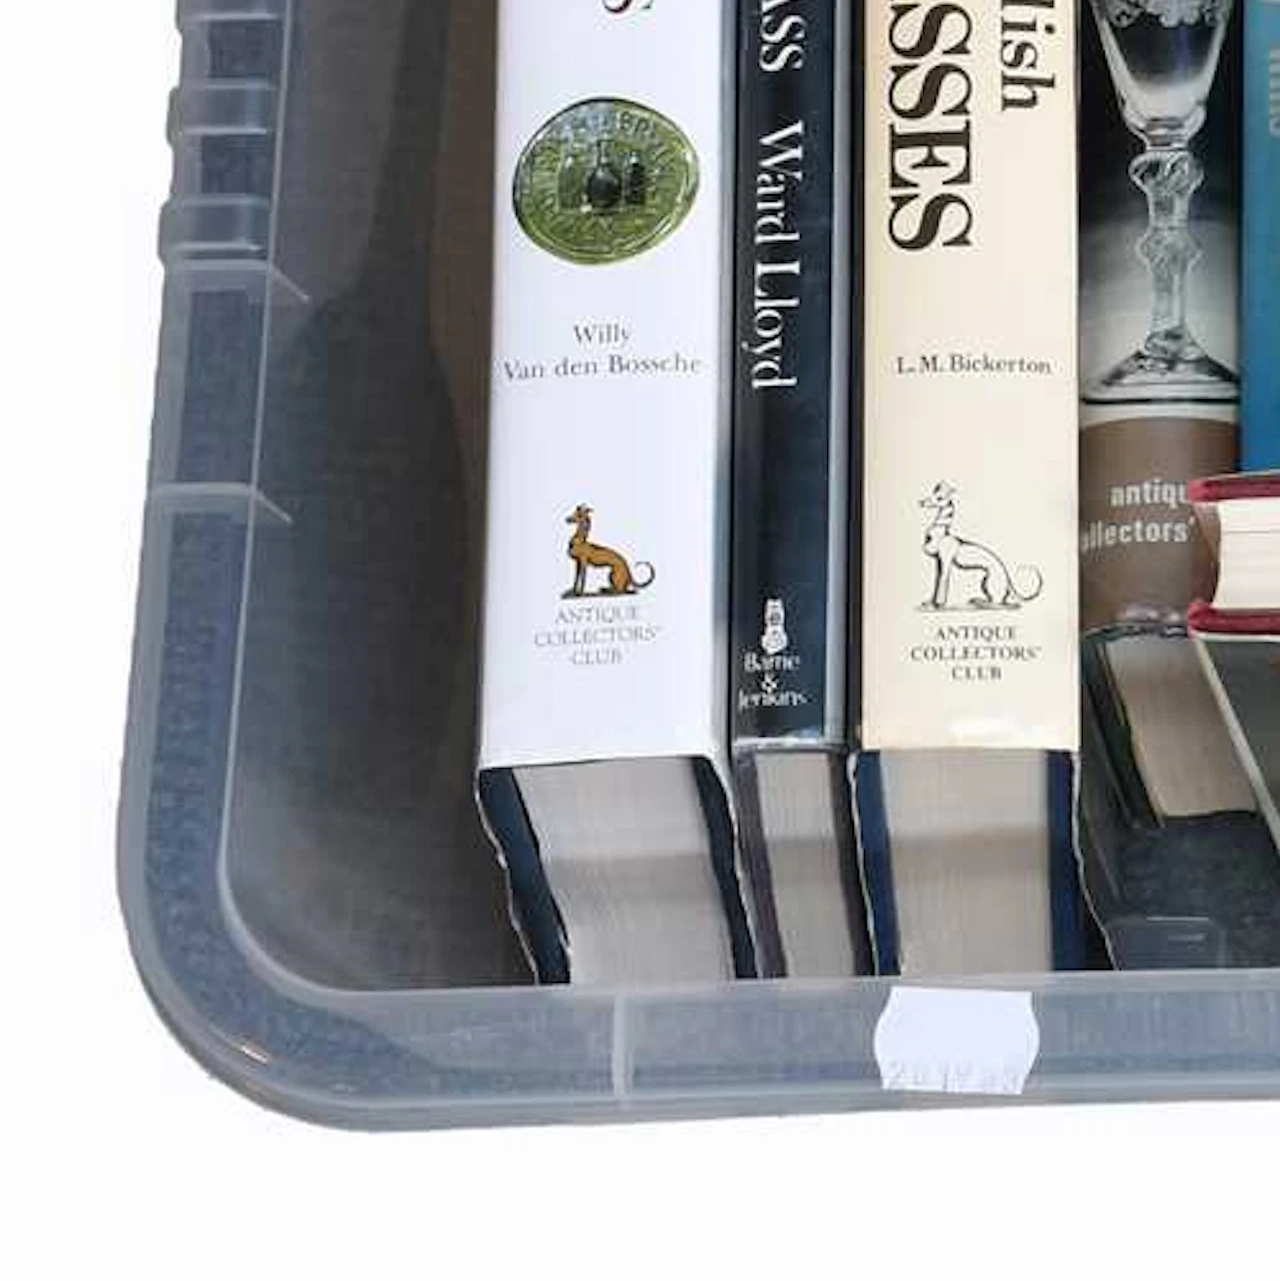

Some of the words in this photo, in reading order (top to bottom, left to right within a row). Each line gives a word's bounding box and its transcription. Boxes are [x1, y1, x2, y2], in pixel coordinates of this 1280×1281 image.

[753, 119, 804, 246] Ward
[573, 321, 630, 348] Willy
[742, 261, 800, 388] Lloyd
[503, 360, 545, 383] Van
[554, 356, 598, 376] den
[608, 354, 701, 375] Bossche
[950, 354, 1052, 375] Bickerton
[1110, 478, 1188, 508] antiqu
[554, 607, 639, 625] ANTIQUE
[936, 626, 1017, 641] ANTIQUE
[568, 650, 623, 666] CLUB
[951, 666, 1002, 681] CLUB
